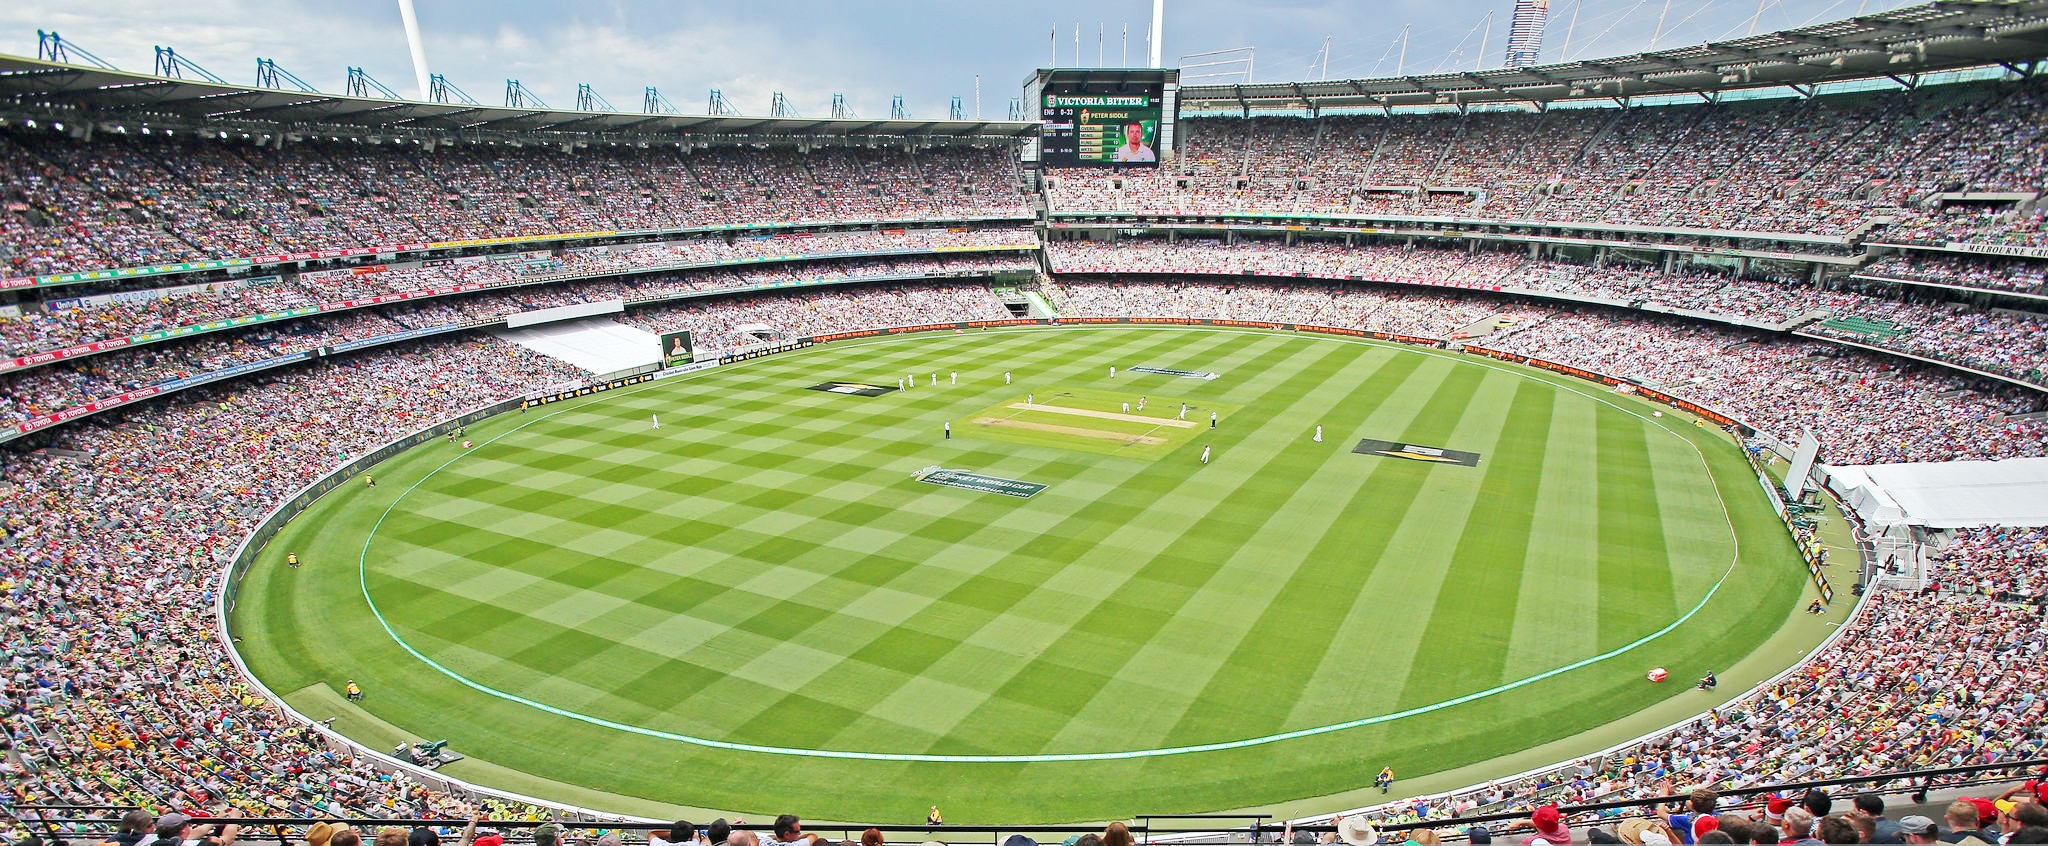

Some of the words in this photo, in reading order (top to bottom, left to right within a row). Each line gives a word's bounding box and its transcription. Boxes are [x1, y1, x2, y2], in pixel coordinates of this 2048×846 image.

[1058, 97, 1105, 106] VICTORIA
[1107, 97, 1142, 106] BITTER
[1968, 245, 2026, 255] MELBOURNE
[2031, 249, 2048, 257] CRI
[10, 278, 33, 287] TOYOTA
[105, 339, 126, 348] TOYOTA
[71, 346, 91, 355] TOYOTA
[33, 354, 55, 363] TOYOTA
[135, 388, 155, 398] TOYOTA
[102, 398, 122, 407] TOYOTA
[67, 407, 88, 417] TOYOTA
[32, 417, 52, 428] TOYOTA
[936, 473, 977, 482] CRICKET
[976, 478, 1013, 487] WORLD
